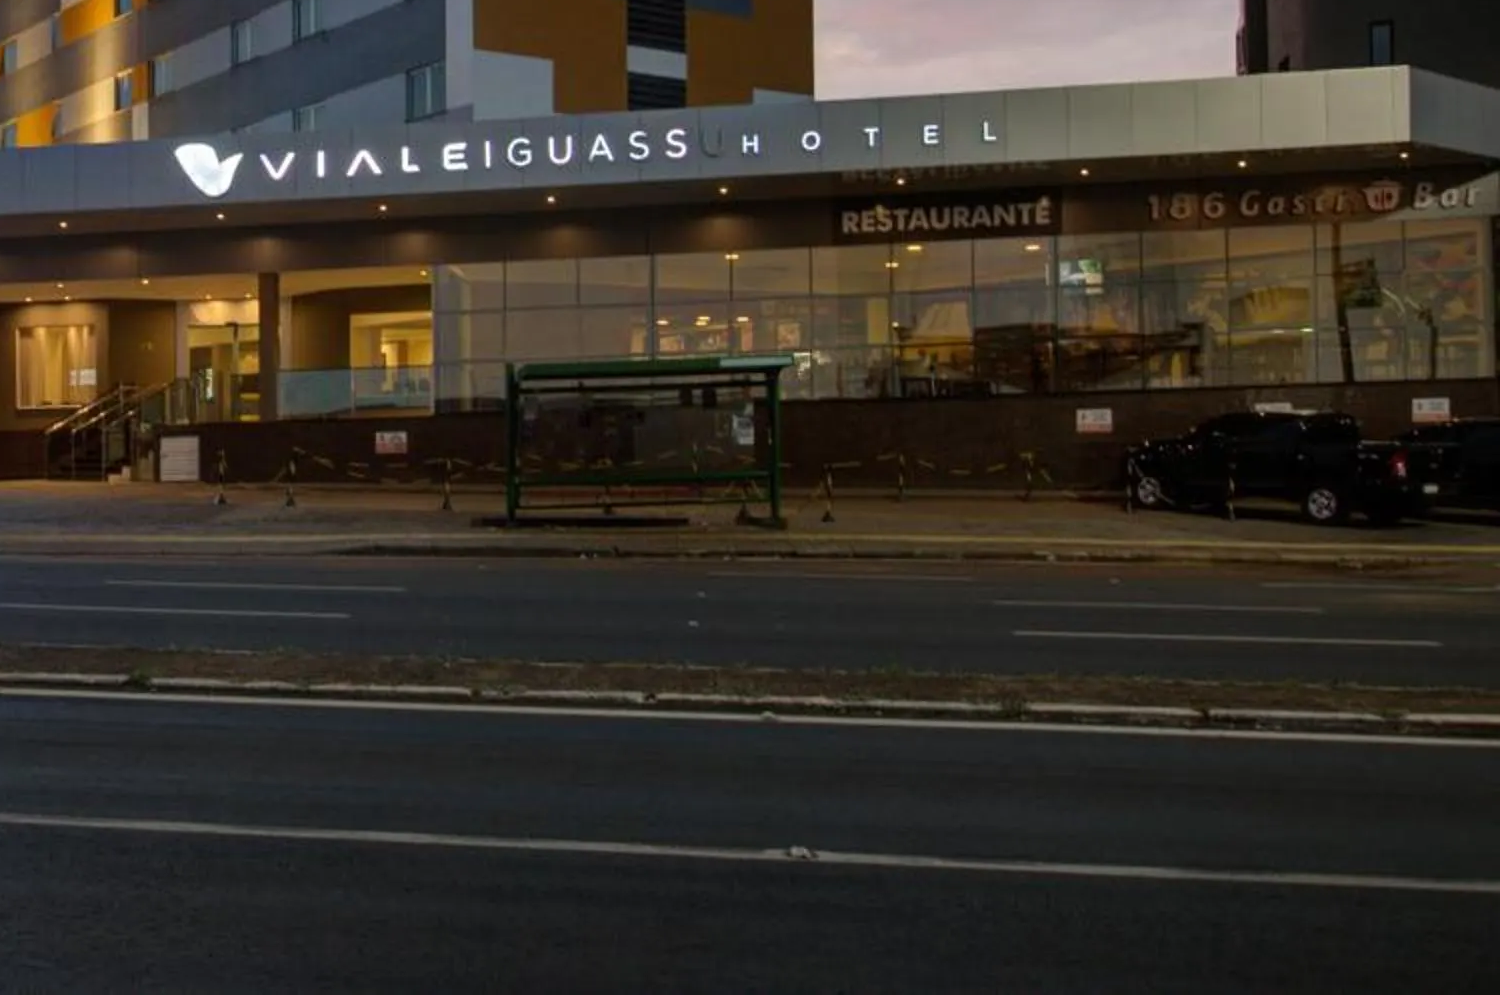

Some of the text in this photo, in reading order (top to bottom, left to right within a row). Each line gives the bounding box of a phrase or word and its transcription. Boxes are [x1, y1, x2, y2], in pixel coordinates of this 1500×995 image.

[742, 121, 996, 154] HOTEL
[841, 200, 1051, 235] RESTAURANTE
[1148, 190, 1226, 220] 186
[1412, 180, 1482, 211] Bar
